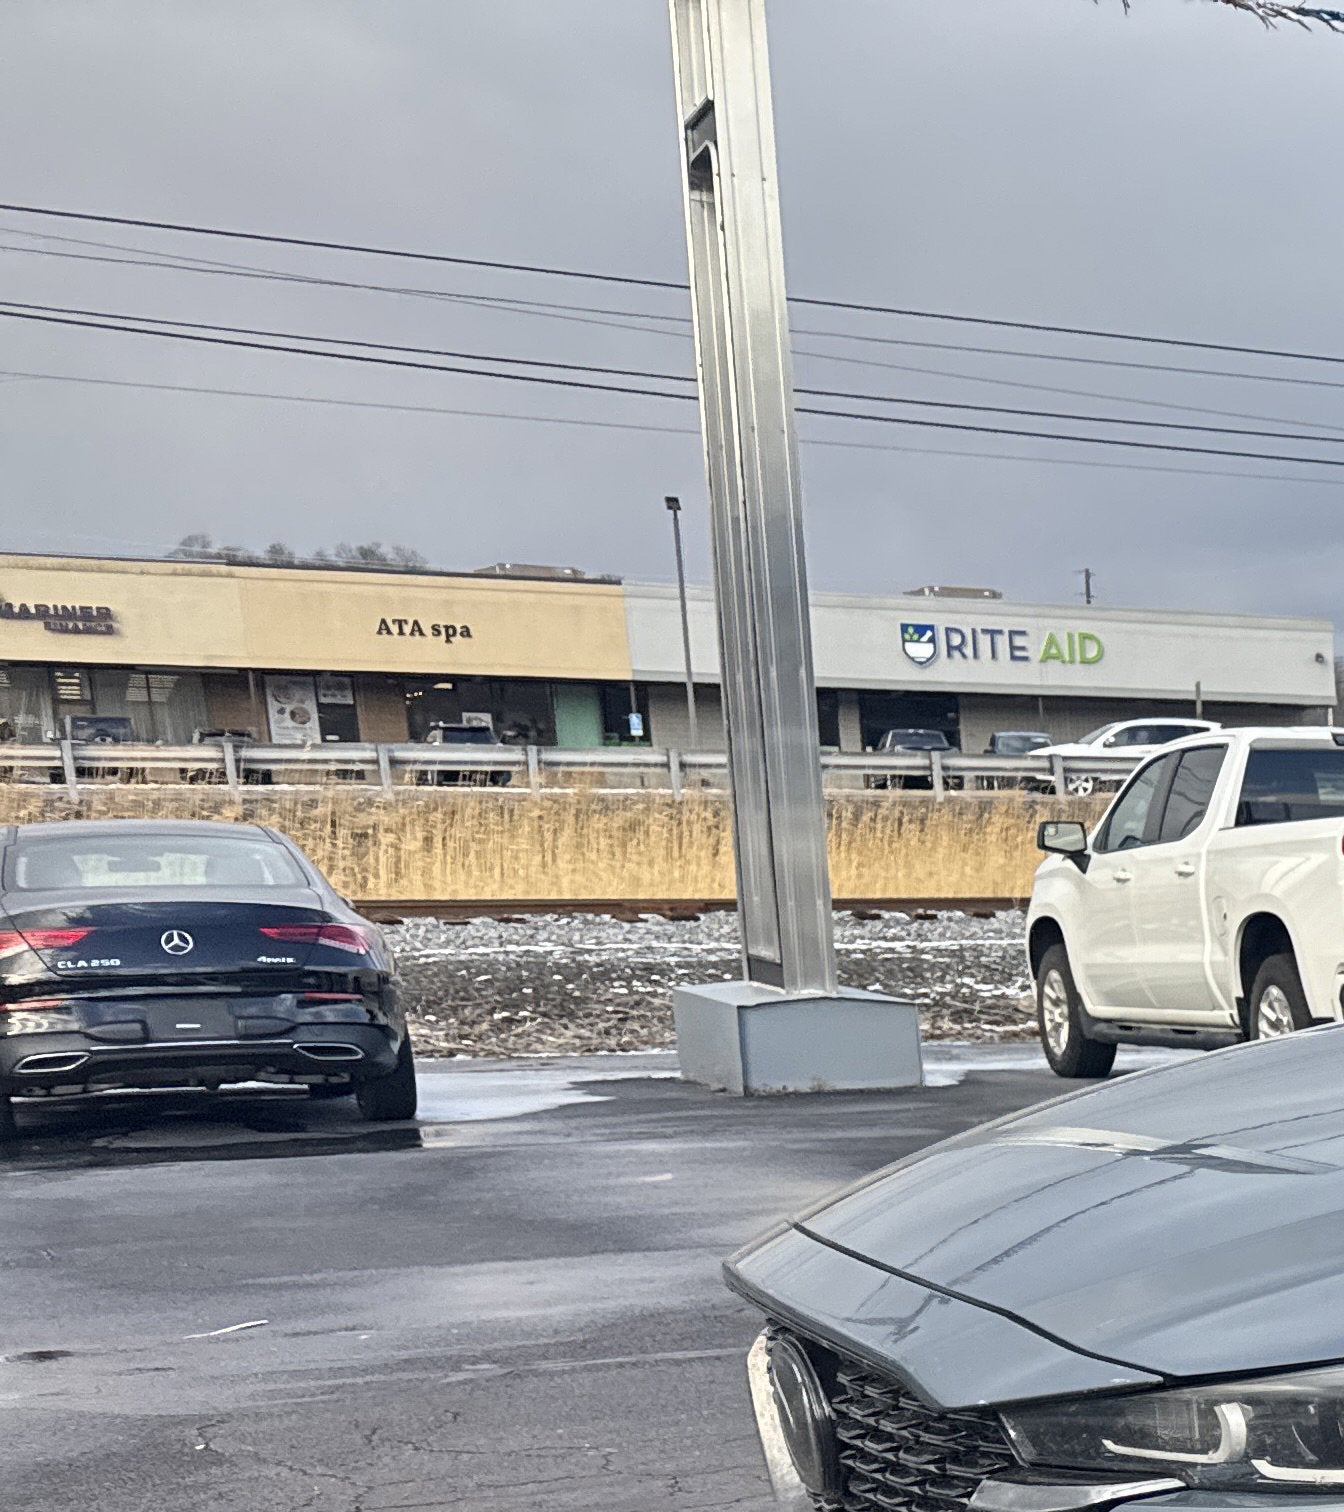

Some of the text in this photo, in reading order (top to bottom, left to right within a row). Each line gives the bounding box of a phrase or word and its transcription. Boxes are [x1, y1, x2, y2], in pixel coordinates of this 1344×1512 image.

[376, 618, 473, 644] ATA spa
[945, 627, 1105, 664] RITE AID
[57, 958, 121, 969] CLA 250
